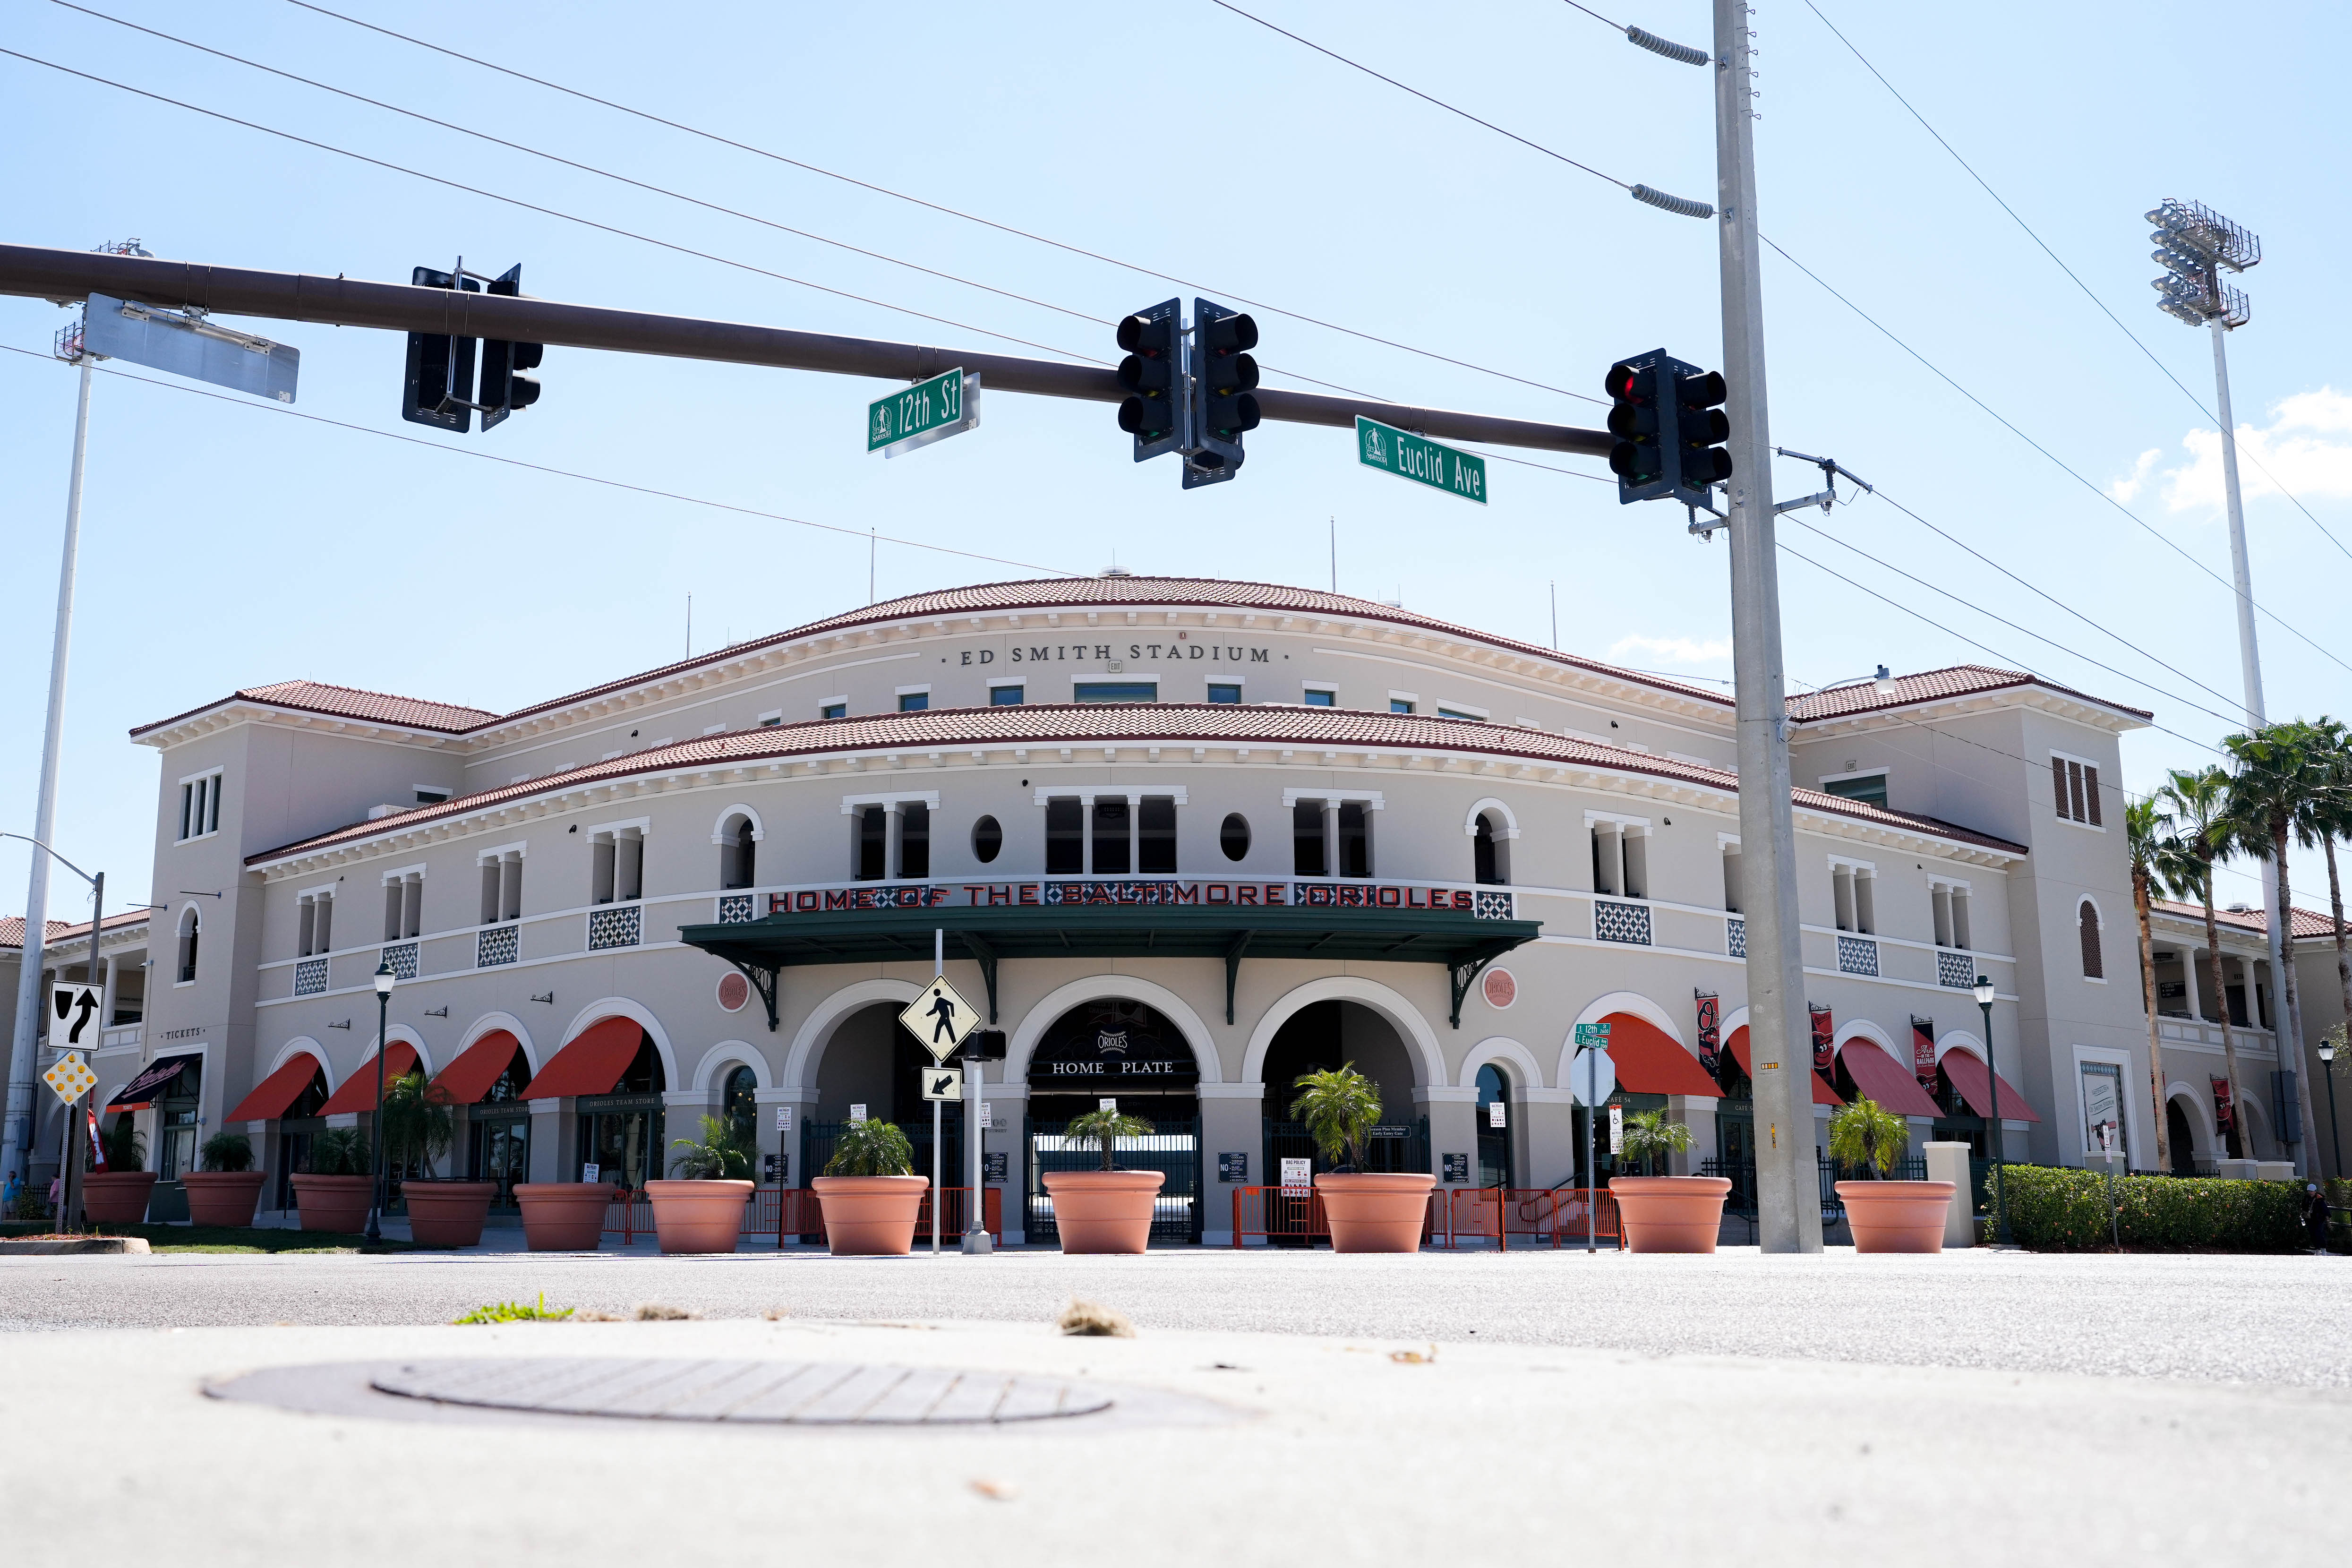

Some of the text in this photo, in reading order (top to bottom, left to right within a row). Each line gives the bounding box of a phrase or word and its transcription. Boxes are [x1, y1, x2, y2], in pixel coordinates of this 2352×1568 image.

[899, 378, 957, 434] 12th St
[872, 429, 891, 445] SARASOTA
[1366, 451, 1387, 466] SARASOTA
[1397, 436, 1480, 496] Euclid Ave
[961, 644, 1269, 665] ED SMITH STADIUM
[769, 883, 1473, 913] HOME OF THE BALTIMORE ORIOLES
[721, 985, 745, 998] ORIOLES
[1486, 980, 1513, 995] ORIOLES
[167, 1028, 200, 1039] TICKETS
[1585, 1025, 1597, 1033] 12th
[1098, 1035, 1128, 1049] ORIOLES
[1582, 1035, 1599, 1046] Euclid
[1916, 1045, 1933, 1054] Arts
[1052, 1062, 1173, 1074] HOME PLATE
